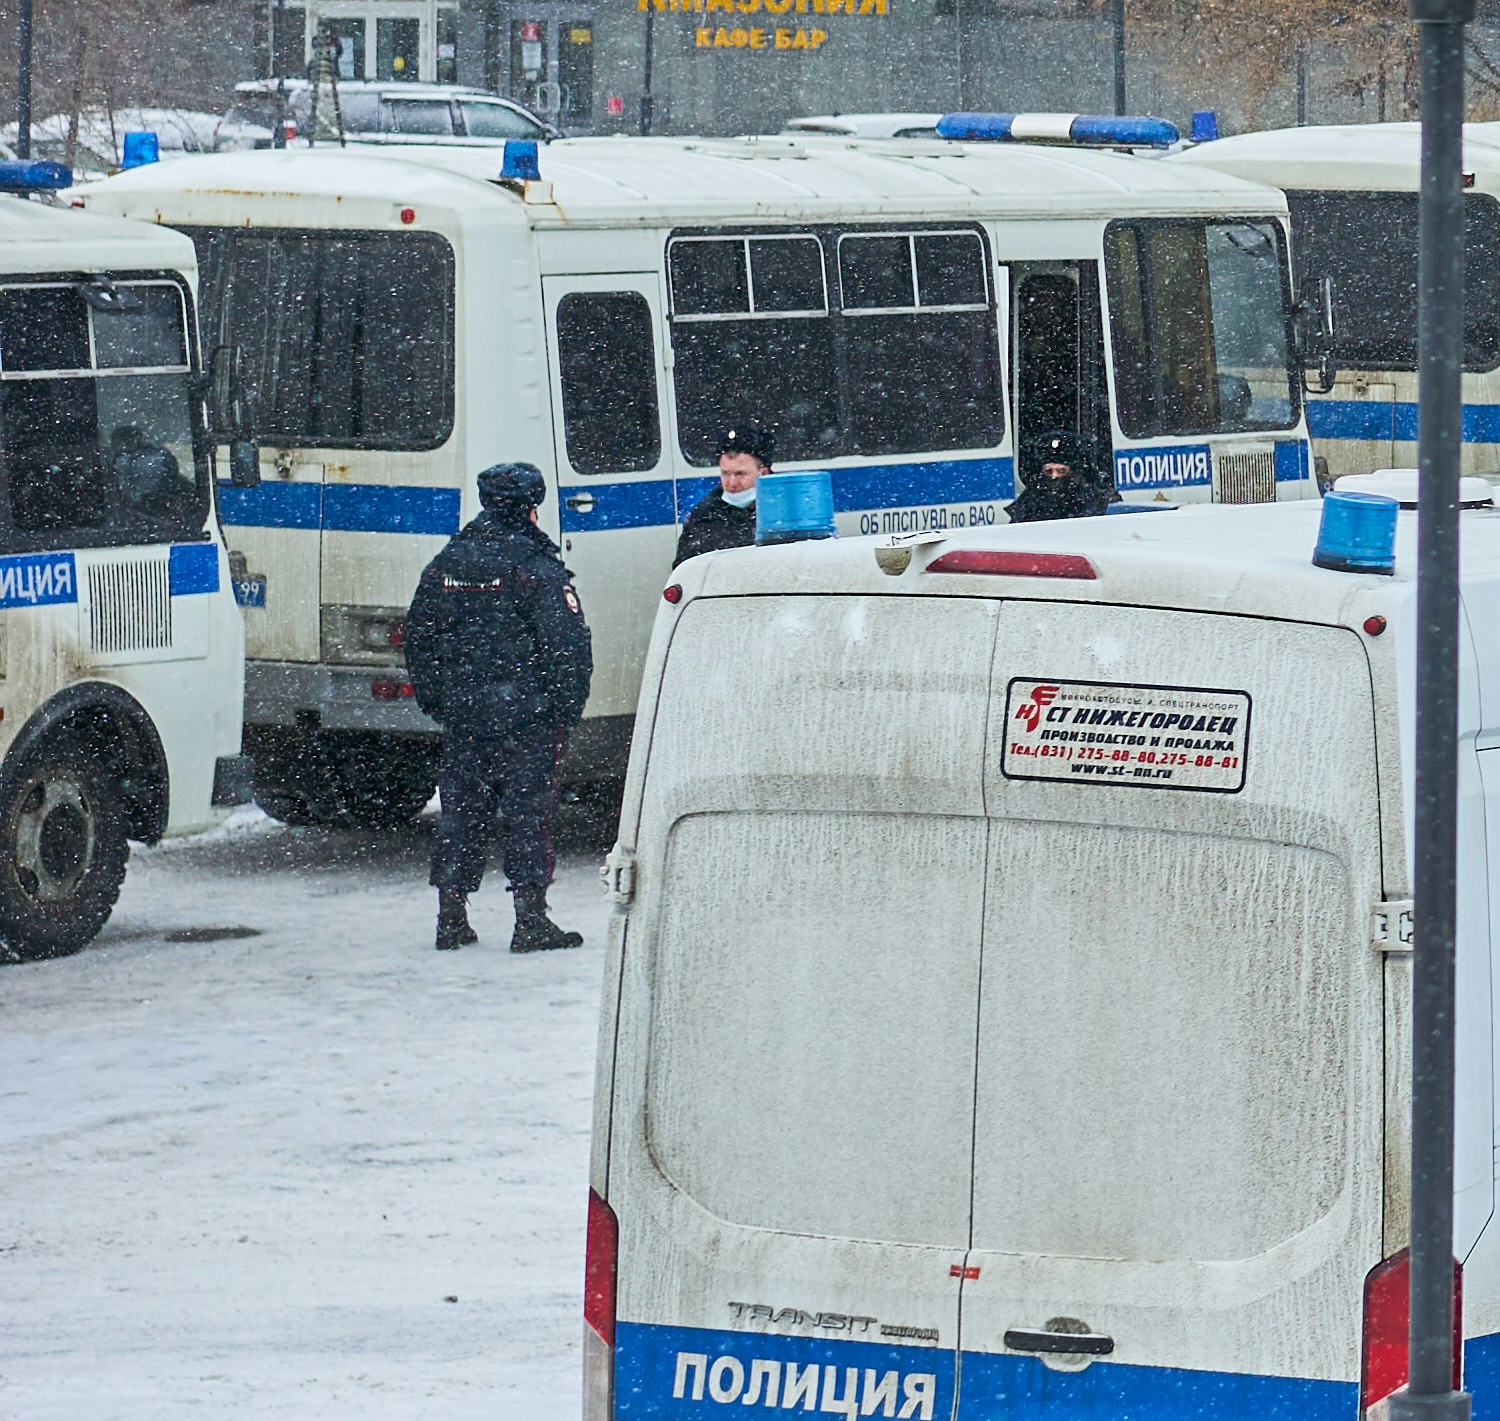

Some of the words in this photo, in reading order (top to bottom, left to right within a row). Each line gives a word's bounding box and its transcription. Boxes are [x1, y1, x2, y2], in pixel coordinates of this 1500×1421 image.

[695, 26, 766, 49] КАФЕ
[775, 27, 827, 50] БАР
[1117, 452, 1208, 484] ПОЛИЦИЯ
[860, 514, 879, 535] ОБ
[883, 510, 918, 533] ППСП
[922, 508, 948, 530] УВД
[951, 512, 966, 528] по
[969, 505, 996, 526] ВАО
[1046, 706, 1071, 723] СТ
[1072, 708, 1238, 736] НИЖЕГОРОДЕЦ
[1041, 729, 1146, 746] ПРОИЗВОДСТВО
[1149, 736, 1161, 746] И
[1165, 737, 1234, 752] ПРОДАЖА
[728, 1302, 878, 1333] TRANSIT
[672, 1351, 936, 1421] ПОЛИЦИЯ
